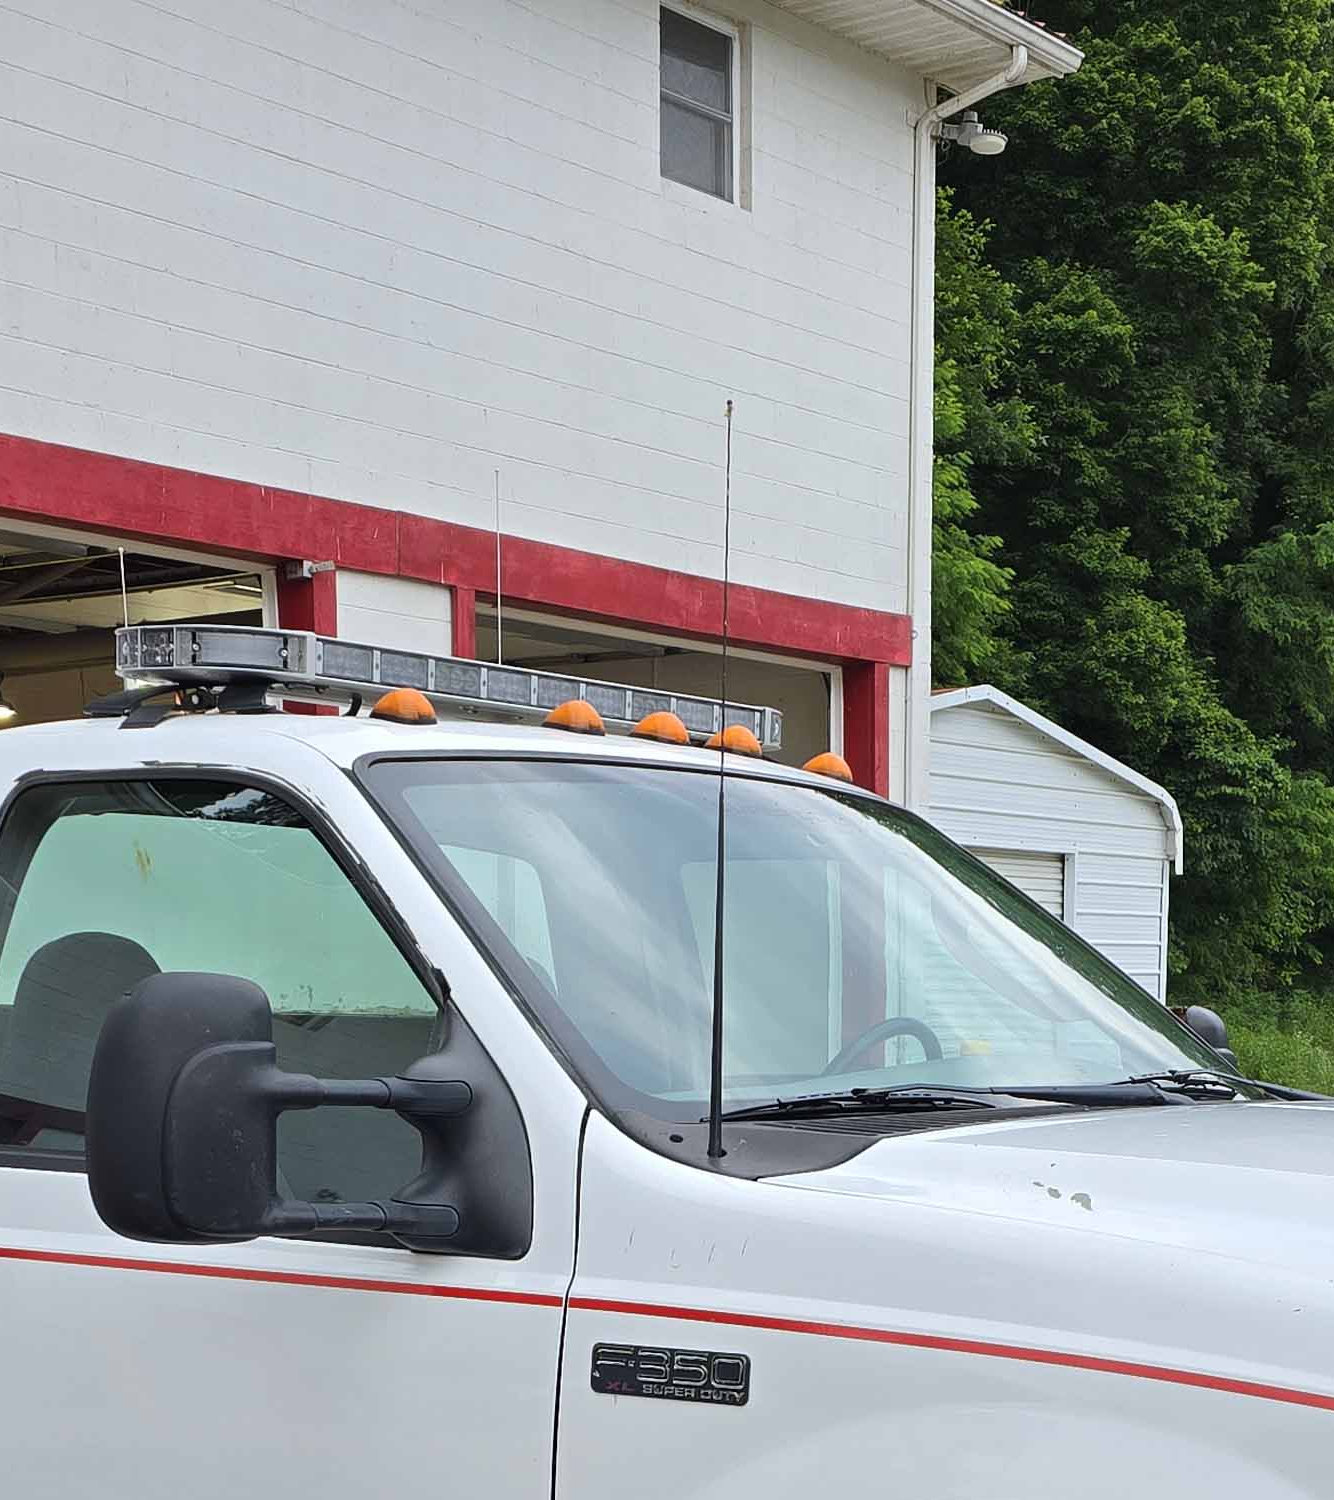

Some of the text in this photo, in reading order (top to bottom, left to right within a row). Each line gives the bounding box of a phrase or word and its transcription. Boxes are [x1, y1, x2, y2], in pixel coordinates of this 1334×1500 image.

[596, 1347, 747, 1390] F-350
[642, 1383, 745, 1402] SUPER DUTY
